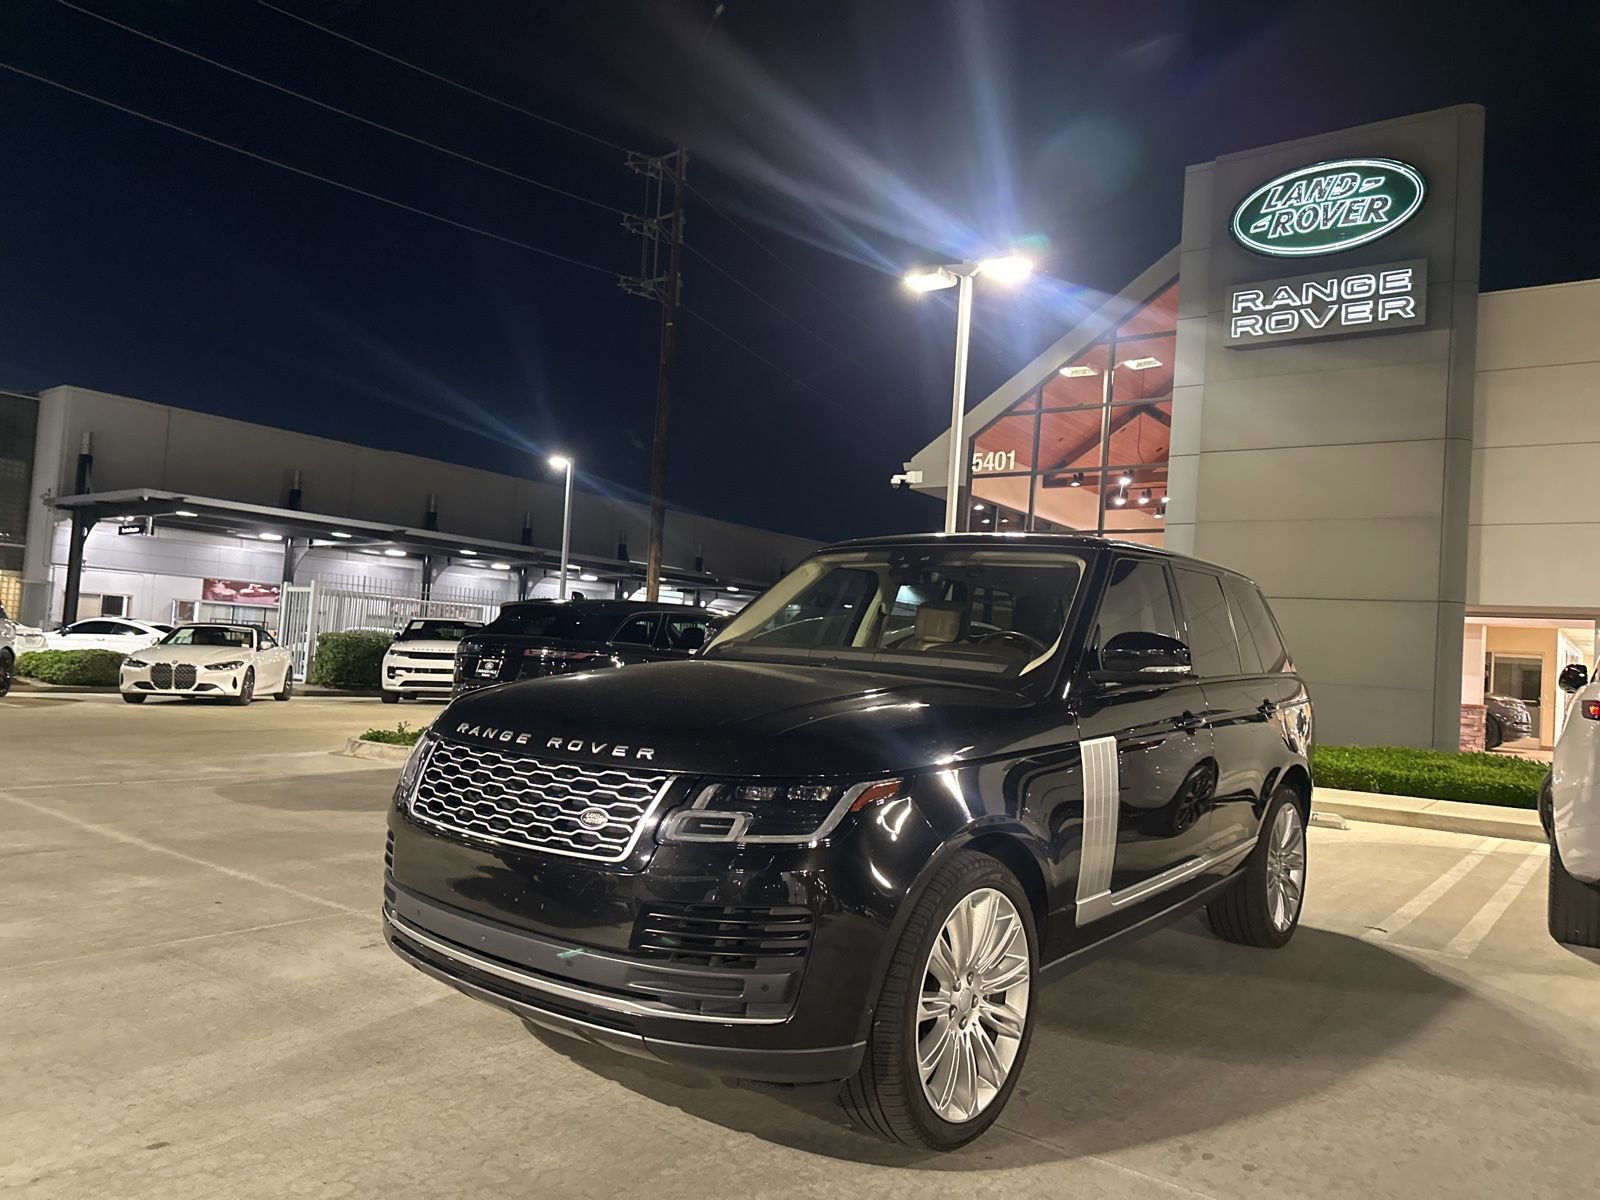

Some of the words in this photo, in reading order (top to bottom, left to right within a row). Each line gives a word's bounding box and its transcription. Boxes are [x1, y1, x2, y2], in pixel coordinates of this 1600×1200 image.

[1232, 268, 1413, 314] RANGE
[1231, 296, 1416, 339] ROVER
[971, 449, 1016, 472] 5401
[455, 722, 532, 745] RANGE
[546, 736, 656, 760] ROVER
